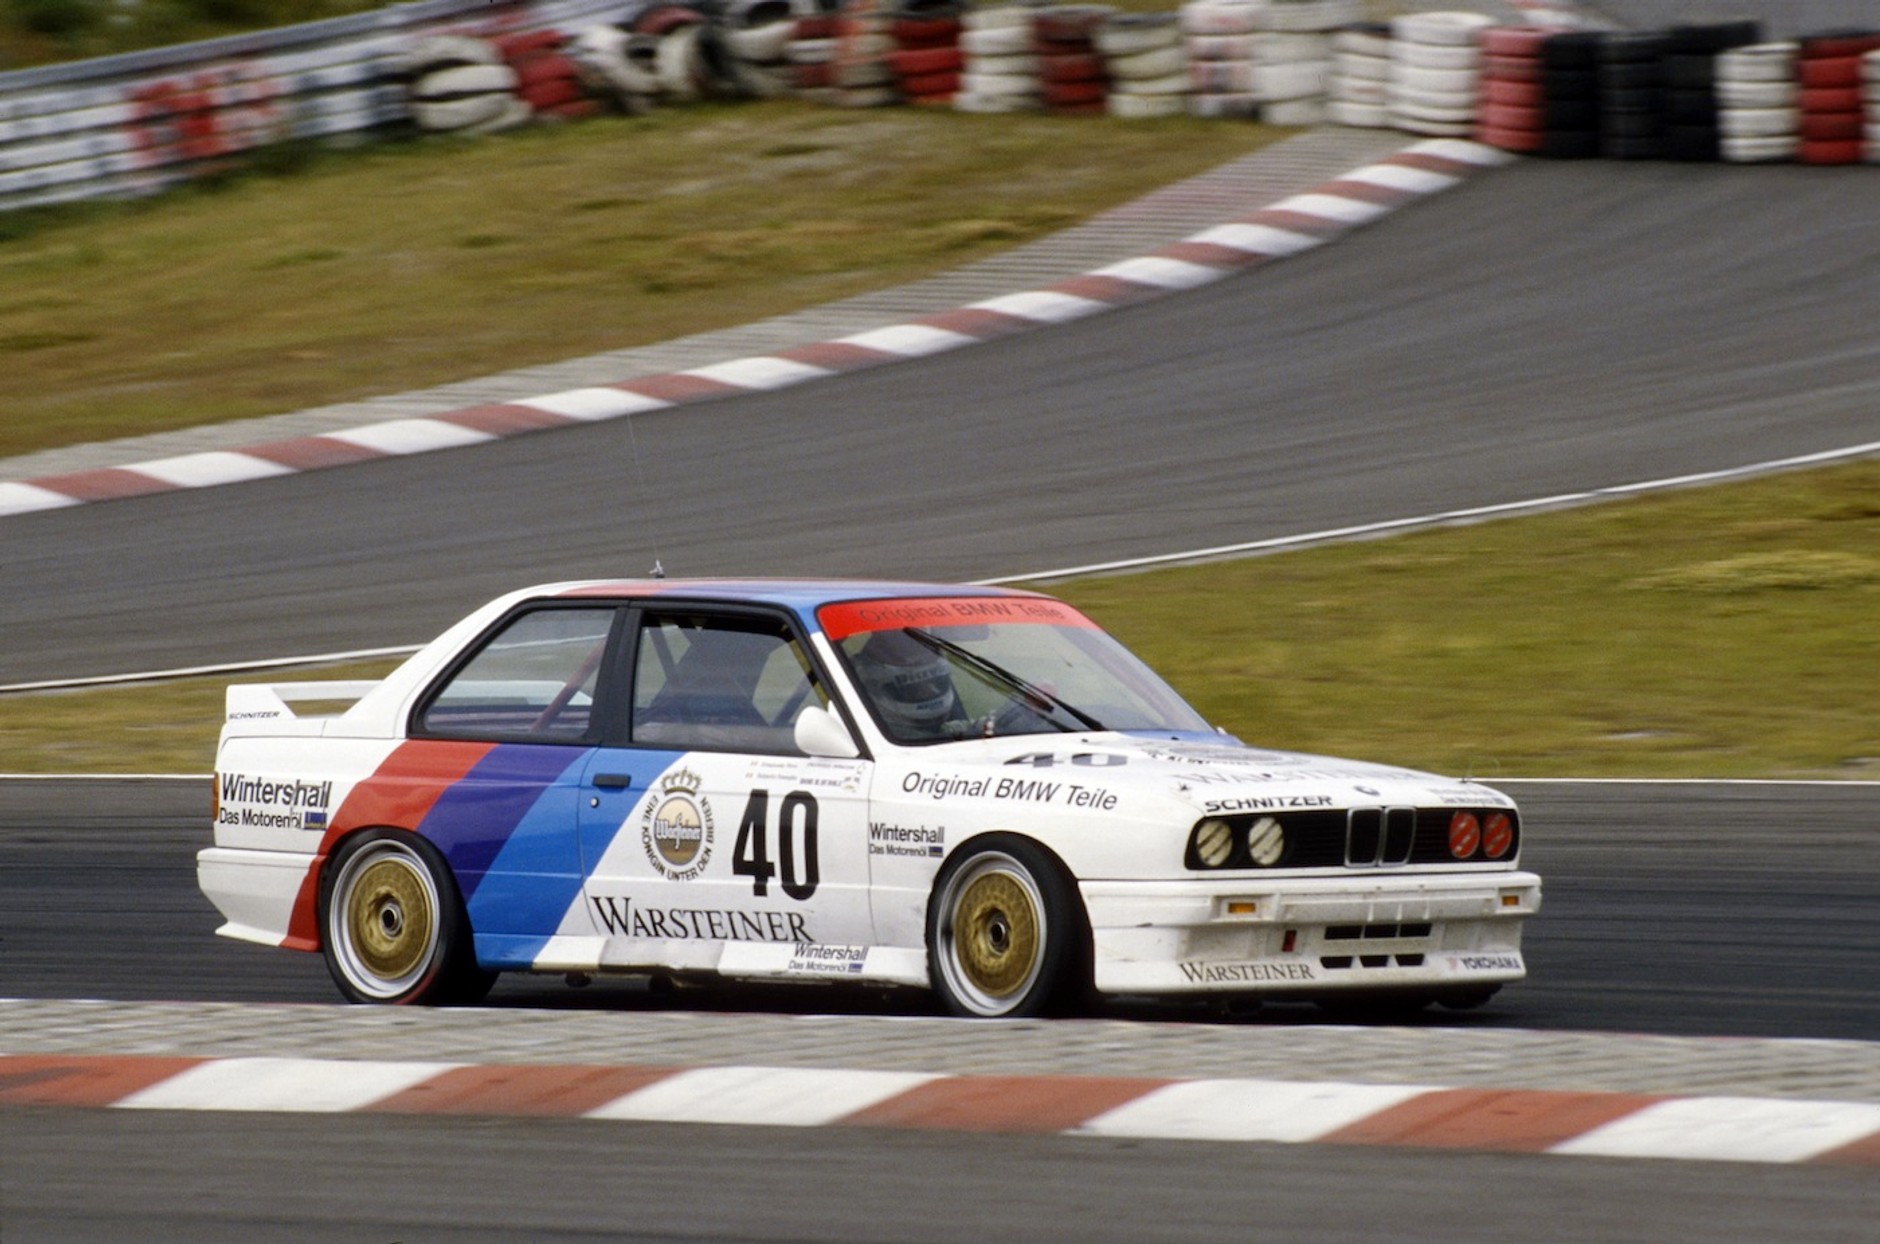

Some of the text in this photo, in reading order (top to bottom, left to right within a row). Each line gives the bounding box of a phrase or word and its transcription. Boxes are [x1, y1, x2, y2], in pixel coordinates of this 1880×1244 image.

[859, 603, 1065, 623] Original BMW Teile
[228, 711, 280, 719] SCHNITZER
[1002, 752, 1128, 768] 40
[222, 772, 333, 808] Wintershall
[902, 772, 1118, 810] Original BMW Teile
[1205, 795, 1334, 812] SCHNITZER
[219, 807, 302, 828] Das Motorenöl
[869, 822, 945, 843] Wintershall
[732, 788, 821, 901] 40
[869, 843, 885, 854] Das
[667, 867, 699, 881] UNTER
[696, 846, 712, 871] DEN
[590, 896, 815, 942] WARSTEINER
[794, 941, 870, 961] Wintershall
[788, 960, 804, 970] Das
[1179, 960, 1315, 983] WARSTEINER
[1461, 956, 1521, 970] YOKOHAMA
